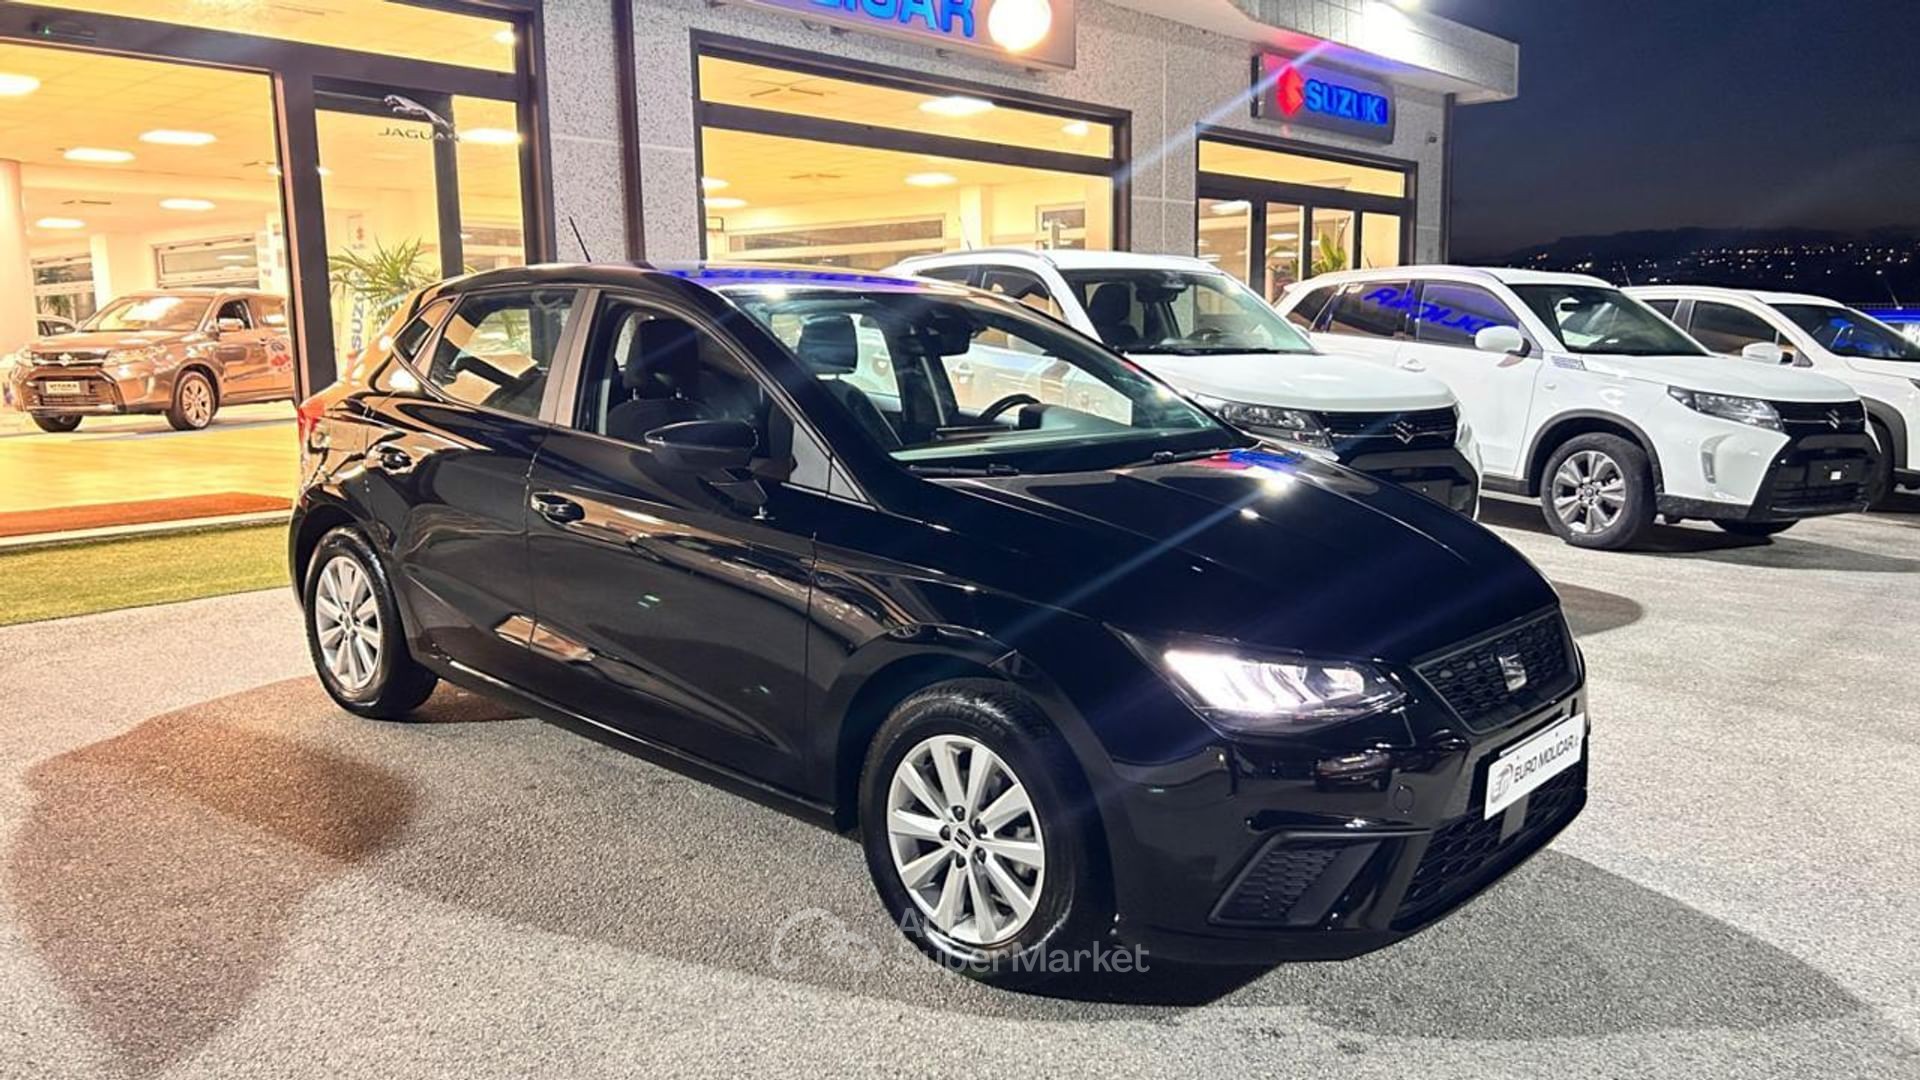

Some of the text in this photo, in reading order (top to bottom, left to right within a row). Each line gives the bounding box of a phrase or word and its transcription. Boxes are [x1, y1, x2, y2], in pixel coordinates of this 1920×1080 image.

[1305, 78, 1389, 125] SUZUKI
[1514, 755, 1537, 783] EURO
[1538, 734, 1574, 768] MOLICAR
